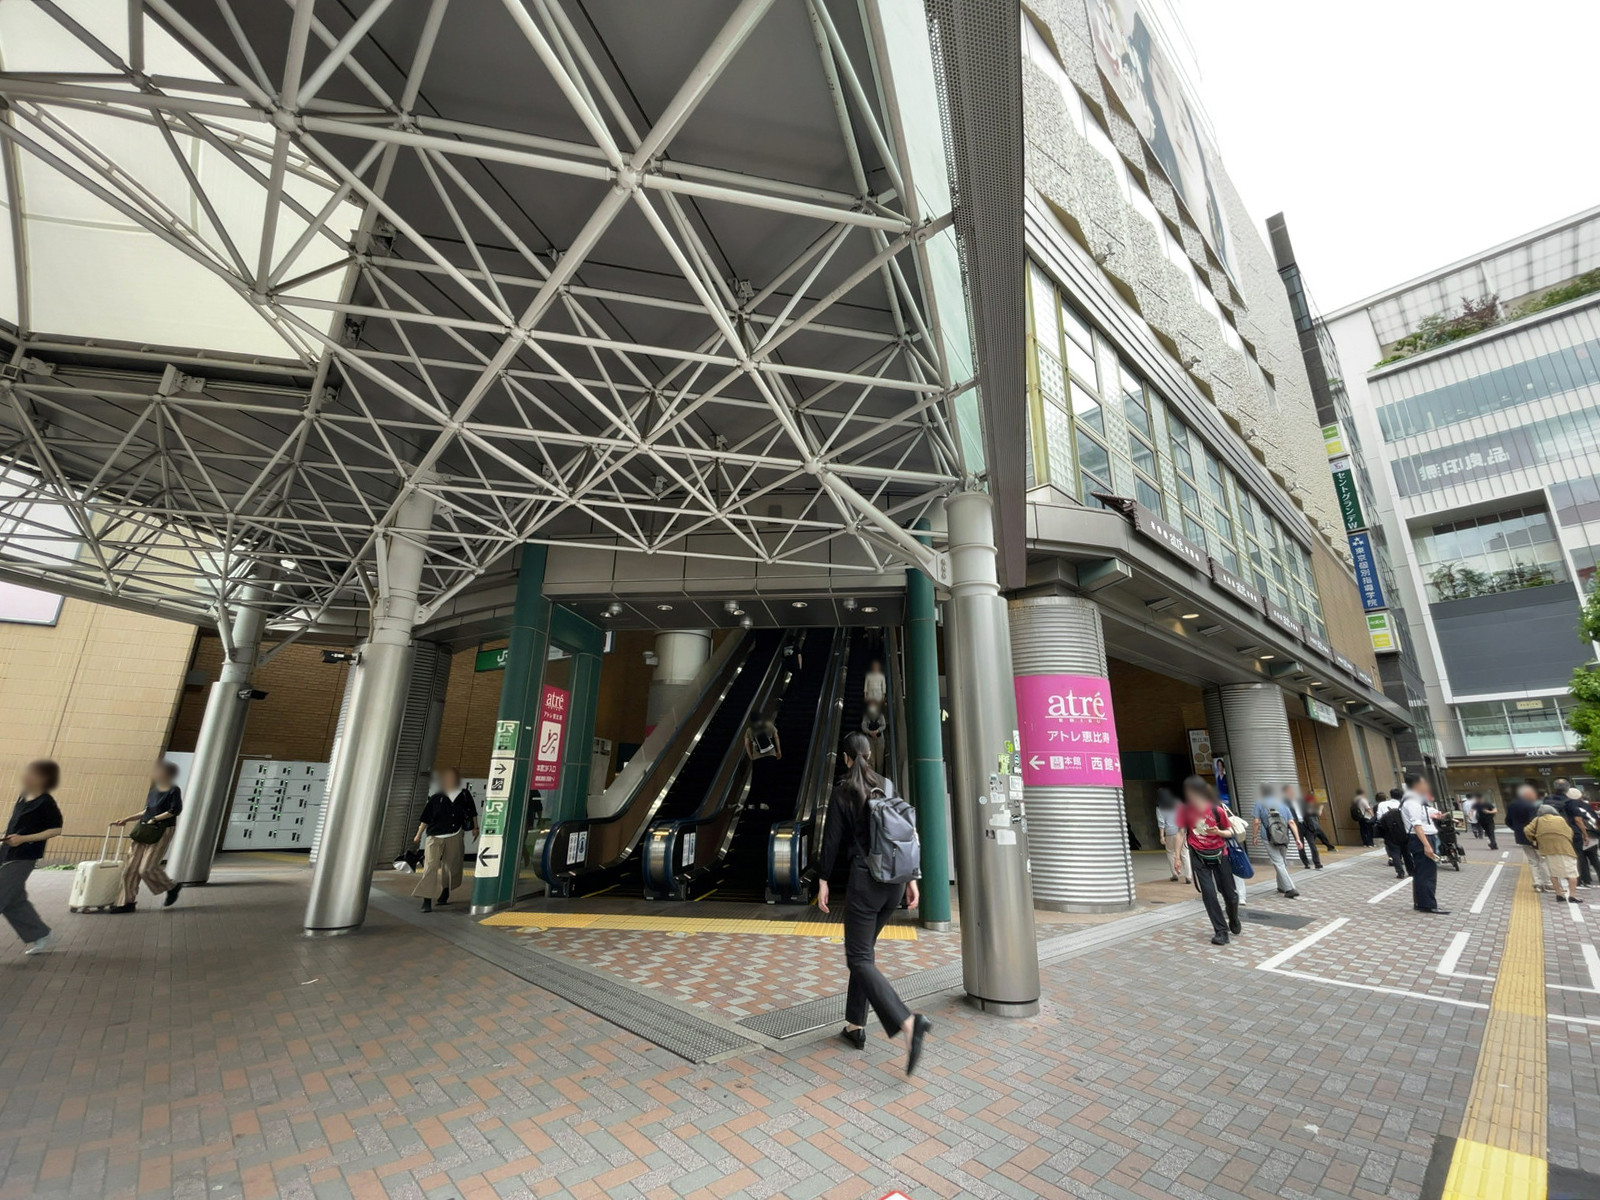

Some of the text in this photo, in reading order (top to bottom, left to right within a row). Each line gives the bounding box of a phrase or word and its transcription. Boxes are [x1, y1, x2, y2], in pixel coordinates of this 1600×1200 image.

[1418, 446, 1511, 481] 無印良品
[1336, 472, 1358, 530] セントグランデW
[1354, 546, 1378, 607] 東京個別指導学院
[546, 691, 564, 709] atré
[1048, 689, 1106, 718] atré
[497, 723, 515, 733] JR
[1047, 730, 1110, 744] アトレ恵比寿
[1064, 756, 1082, 766] 本館
[1090, 756, 1114, 771] 西館
[486, 801, 504, 813] JR
